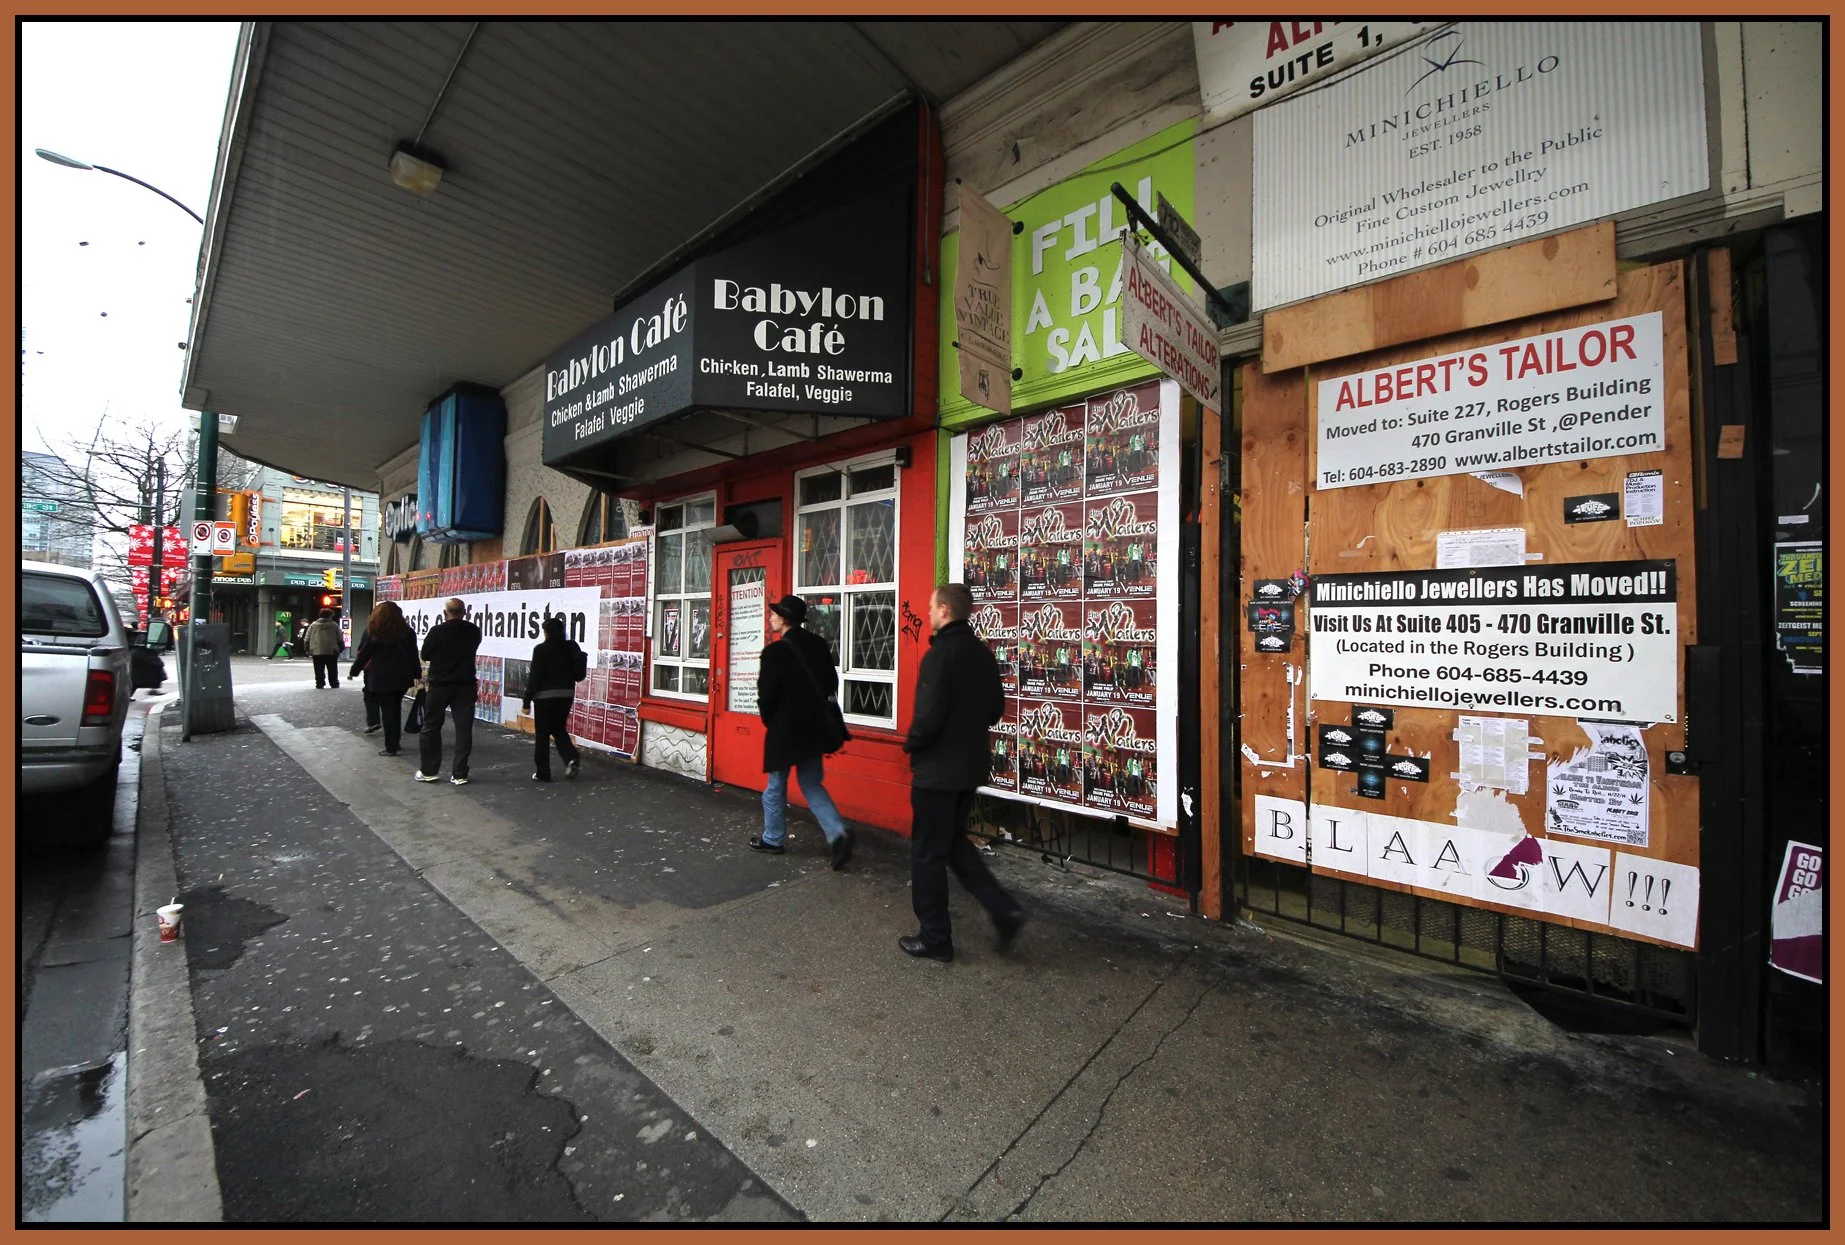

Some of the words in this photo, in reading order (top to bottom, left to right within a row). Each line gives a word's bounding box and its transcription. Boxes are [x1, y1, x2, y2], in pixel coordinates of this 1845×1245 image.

[1249, 41, 1334, 99] SUITE
[1357, 25, 1383, 48] 1,
[1345, 54, 1560, 148] MINICHIELLO
[1402, 102, 1491, 141] JEWELLERS
[1409, 139, 1442, 160] EST.
[1449, 125, 1482, 146] 1958
[1314, 198, 1376, 228] Original
[1382, 168, 1475, 205] Wholesaler
[1482, 161, 1498, 175] to
[1505, 149, 1533, 166] the
[1541, 124, 1604, 155] Public
[1356, 217, 1390, 234] Fine
[1396, 194, 1459, 221] Custom
[1466, 166, 1548, 199] Jewellry
[1032, 176, 1159, 276] FILL
[1326, 181, 1590, 266] www.minichiellojewellers.com
[1357, 255, 1408, 276] Phone
[1413, 247, 1422, 260] #
[1428, 236, 1459, 255] 604
[1464, 226, 1497, 246] 685
[1503, 211, 1549, 233] 4439
[714, 279, 884, 321] Babylon
[964, 297, 1004, 328] VALUE
[968, 284, 1000, 310] TRUE
[1026, 288, 1054, 335] A
[958, 308, 1010, 344] VINTAGE
[1128, 266, 1182, 337] ALBERT'S
[1185, 320, 1217, 371] TAILOR
[547, 335, 624, 402] Babylon
[630, 293, 688, 356] Café
[754, 320, 845, 355] Café
[1046, 308, 1131, 373] SAL
[1499, 324, 1637, 381] TAILOR
[818, 366, 893, 384] Shawerma
[1139, 322, 1210, 401] ALTERATIONS
[552, 400, 583, 427] Chicken
[618, 354, 678, 396] Shawerma
[746, 382, 800, 401] Falafel,
[805, 384, 853, 402] Veggie
[1326, 418, 1377, 440] Moved
[1382, 415, 1403, 431] to:
[1407, 409, 1450, 427] Suite
[1454, 402, 1491, 421] 227,
[1497, 391, 1560, 415] Rogers
[1566, 377, 1652, 403] Building
[575, 413, 605, 440] Falafel
[610, 398, 644, 432] Veggie
[1088, 390, 1160, 433] Wailers
[1023, 410, 1084, 450] Wailers
[1412, 432, 1441, 449] 470
[1445, 422, 1522, 445] Granville
[1528, 417, 1546, 432] St
[1323, 470, 1346, 484] Tel:
[1349, 455, 1447, 481] 604-683-2890
[1454, 430, 1657, 469] www.albertstailor.com
[1052, 487, 1080, 497] VENUE
[1089, 481, 1113, 490] JANUARY
[1122, 474, 1154, 484] VENUE
[250, 493, 260, 534] Payless
[1024, 494, 1045, 502] JANUARY
[1022, 506, 1082, 545] Wailers
[1086, 497, 1157, 538] Wailers
[732, 588, 763, 600] TTENTION
[1051, 585, 1079, 595] VENUE
[1120, 582, 1152, 593] VENUE
[1316, 578, 1416, 603] Minichiello
[1420, 575, 1518, 599] Jewellers
[1523, 573, 1565, 598] Has
[1571, 570, 1667, 597] Moved!!
[465, 602, 586, 643] fghanistan
[1021, 603, 1081, 640] Wailers
[1085, 601, 1155, 641] Wailers
[1314, 613, 1349, 635] Visit
[1352, 615, 1373, 634] Us
[1375, 615, 1393, 634] At
[1396, 613, 1442, 634] Suite
[1446, 613, 1481, 634] 405
[1496, 613, 1531, 634] 470
[1537, 610, 1634, 635] Granville
[1640, 613, 1671, 635] St.
[1336, 639, 1405, 655] (Located
[1410, 639, 1425, 654] in
[1430, 639, 1458, 655] the
[1463, 641, 1530, 660] Rogers
[1534, 641, 1622, 662] Building
[1050, 682, 1079, 694] VENUE
[1369, 663, 1430, 680] Phone
[1436, 665, 1589, 686] 604-685-4439
[1087, 690, 1112, 698] JANUARY
[1120, 687, 1152, 700] VENUE
[1344, 683, 1622, 714] minichiellojewellers.com
[1020, 702, 1081, 743] Wailers
[1085, 708, 1155, 752] Wailers
[1022, 783, 1044, 792] JANUARY
[1051, 782, 1079, 797] VENUE
[1087, 794, 1111, 804] JANUARY
[1120, 795, 1153, 812] VENUE
[1792, 868, 1818, 888] GO
[1796, 852, 1822, 872] GO
